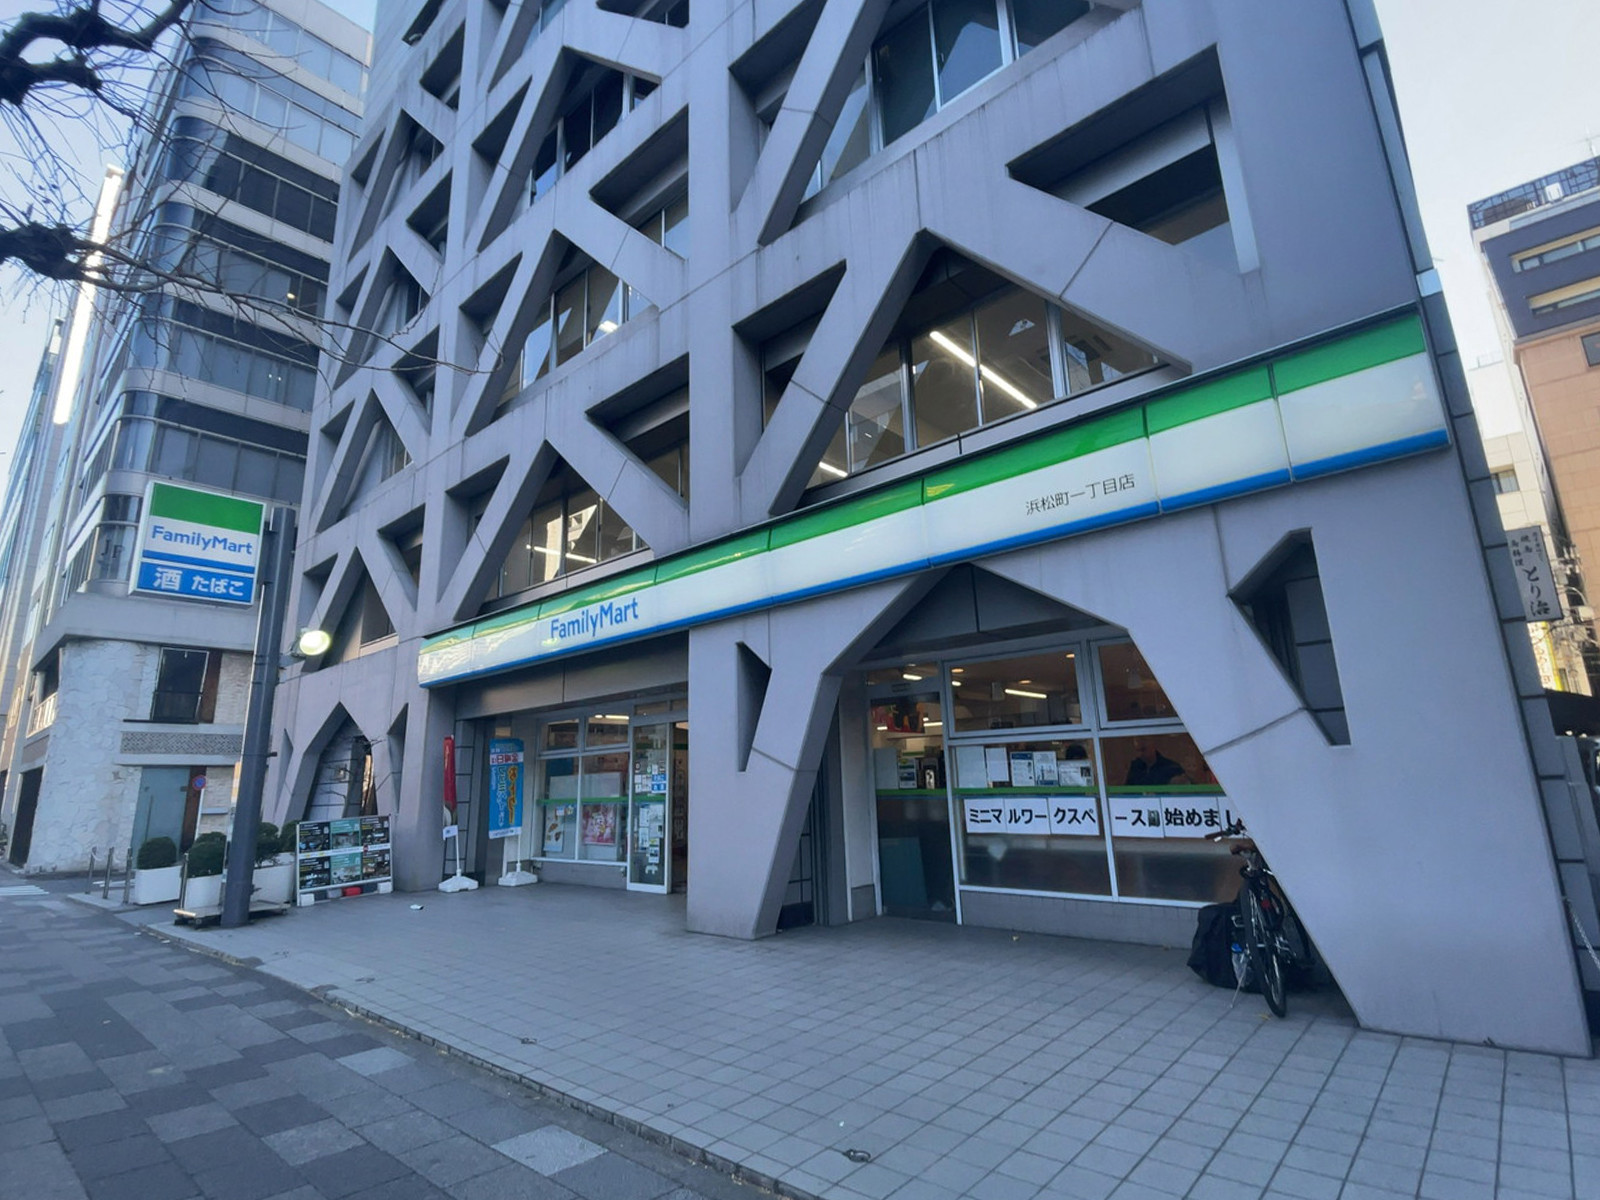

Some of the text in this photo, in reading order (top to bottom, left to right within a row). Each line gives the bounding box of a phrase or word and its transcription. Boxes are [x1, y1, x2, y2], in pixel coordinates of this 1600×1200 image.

[1025, 473, 1135, 516] 浜松町一丁目店
[151, 524, 253, 555] FamilyMart
[153, 566, 245, 597] 酒 たばこ
[550, 597, 639, 639] FamilyMart
